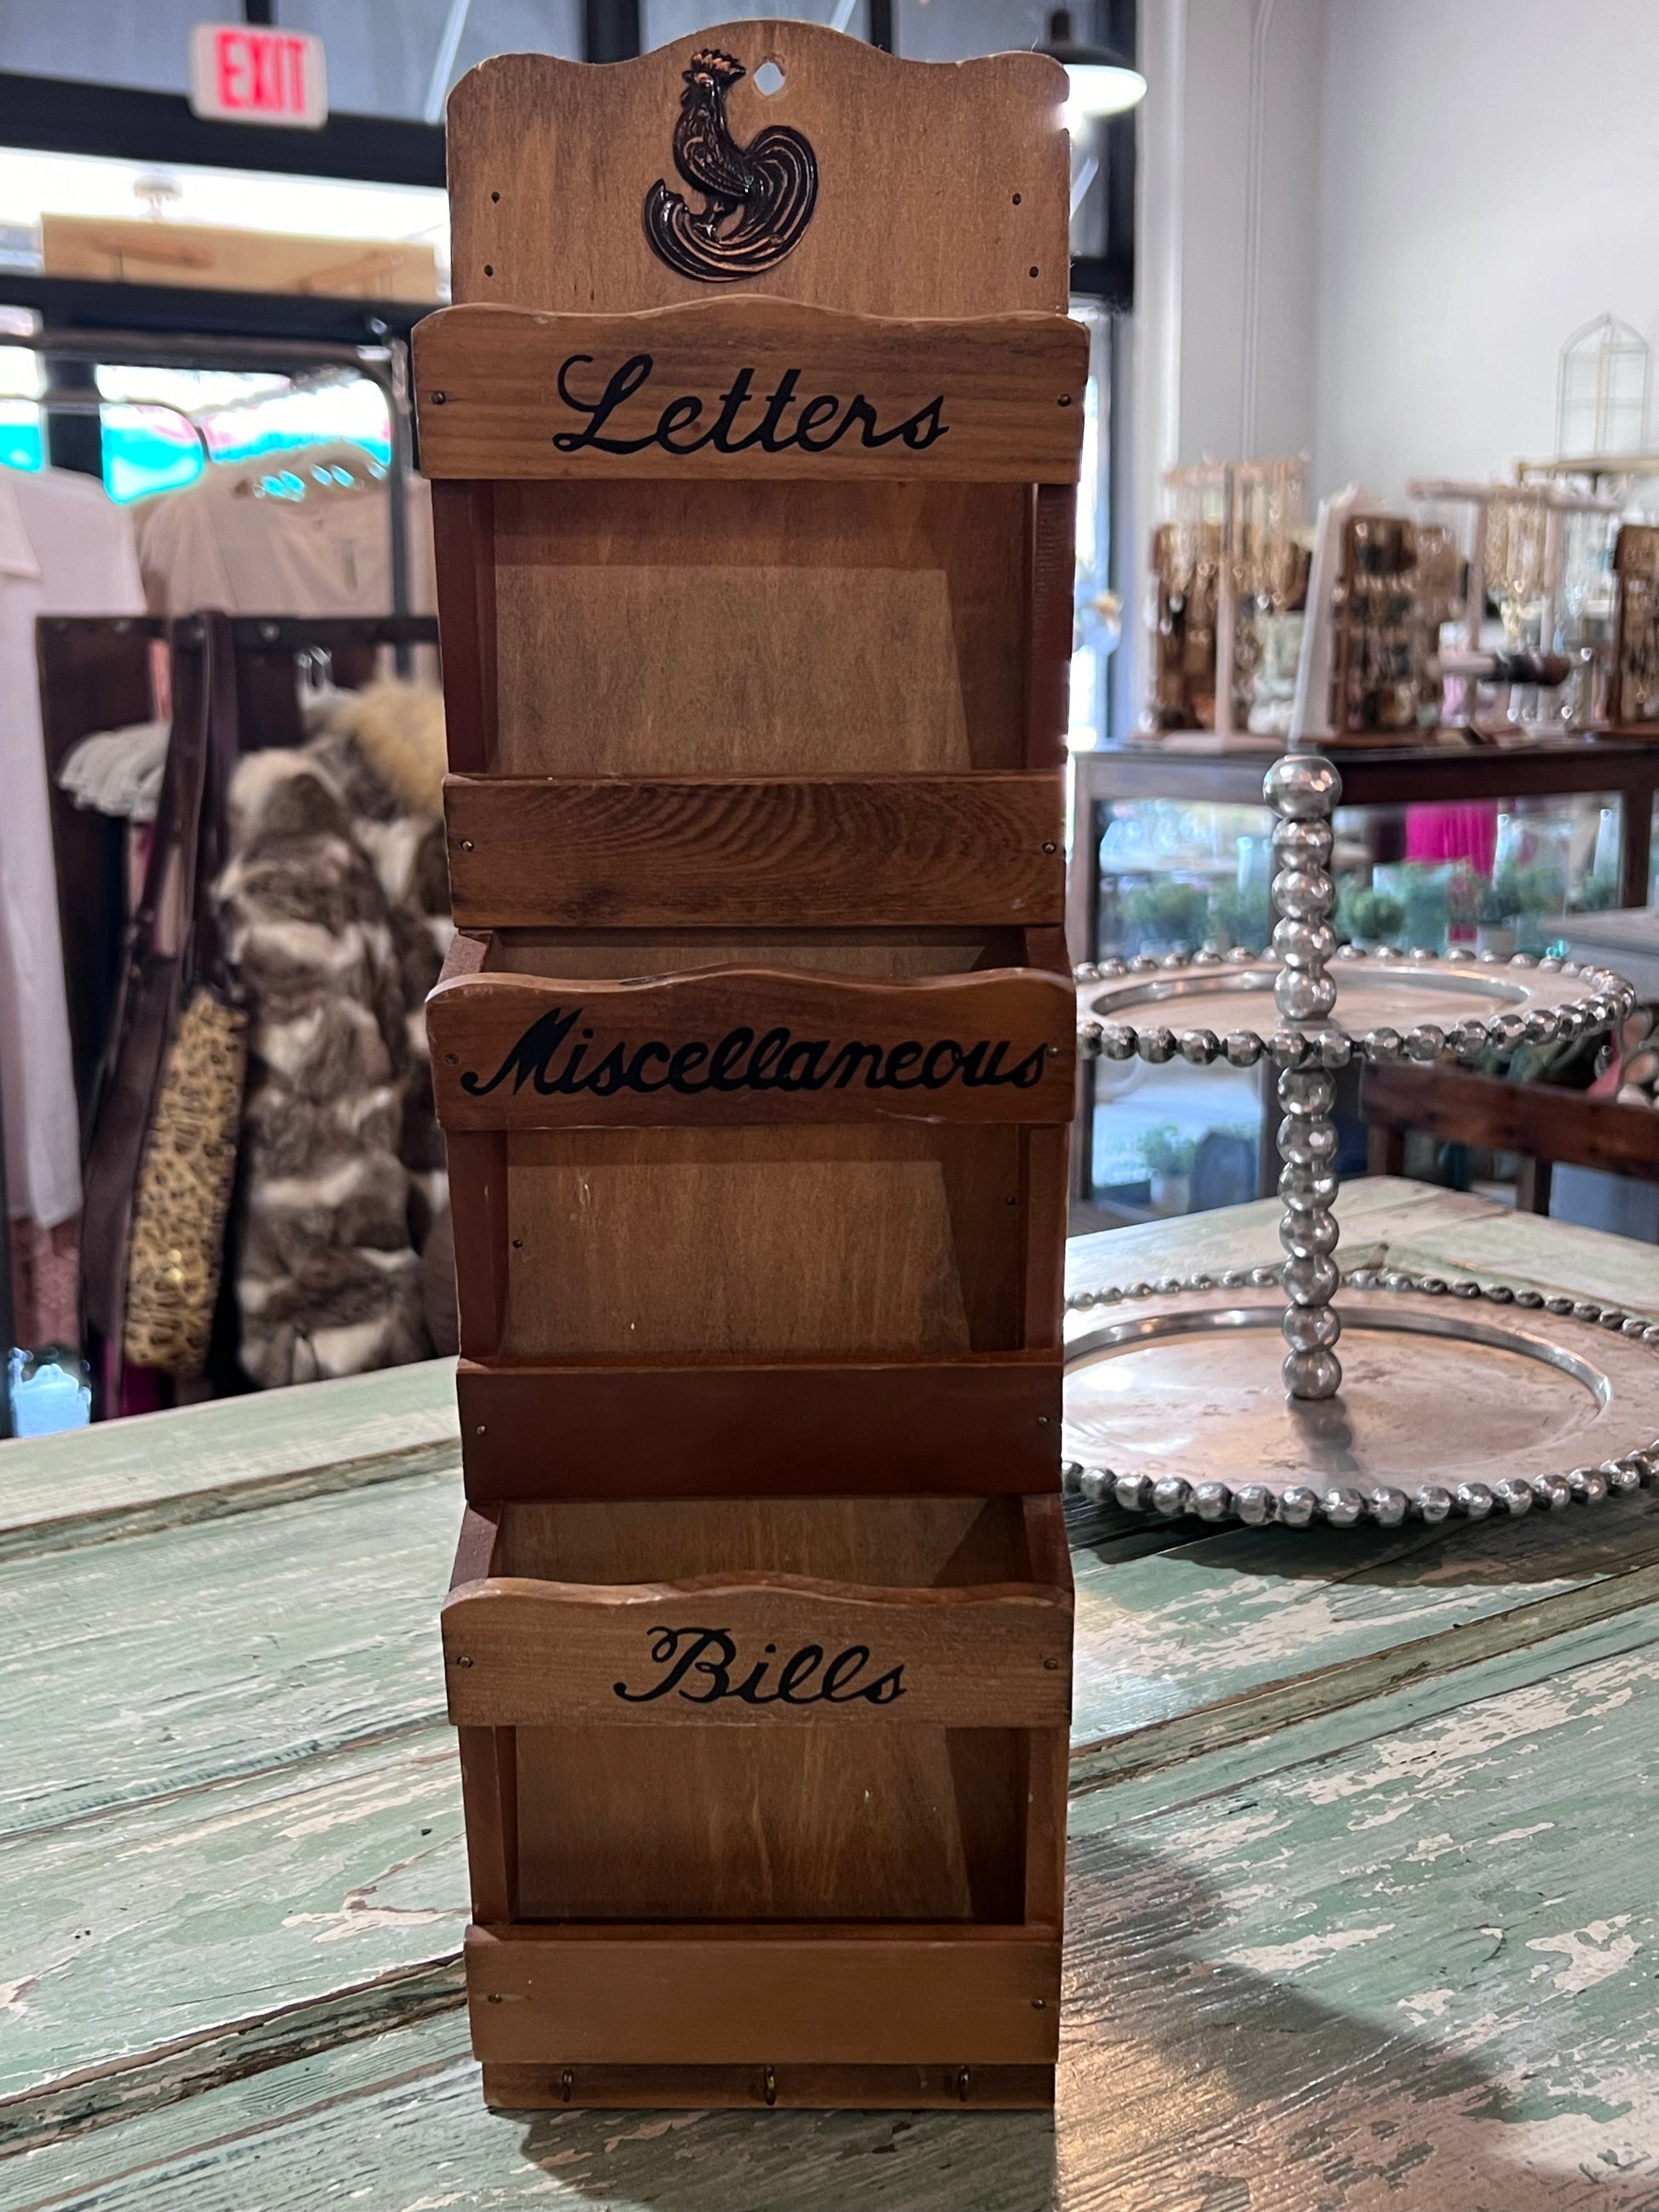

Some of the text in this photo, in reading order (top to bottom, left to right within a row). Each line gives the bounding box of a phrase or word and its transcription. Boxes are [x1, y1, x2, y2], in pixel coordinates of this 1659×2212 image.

[216, 30, 307, 115] EXIT
[552, 354, 950, 454] Letters
[460, 1007, 1049, 1096] Miscellaneous
[613, 1626, 908, 1704] Bills
